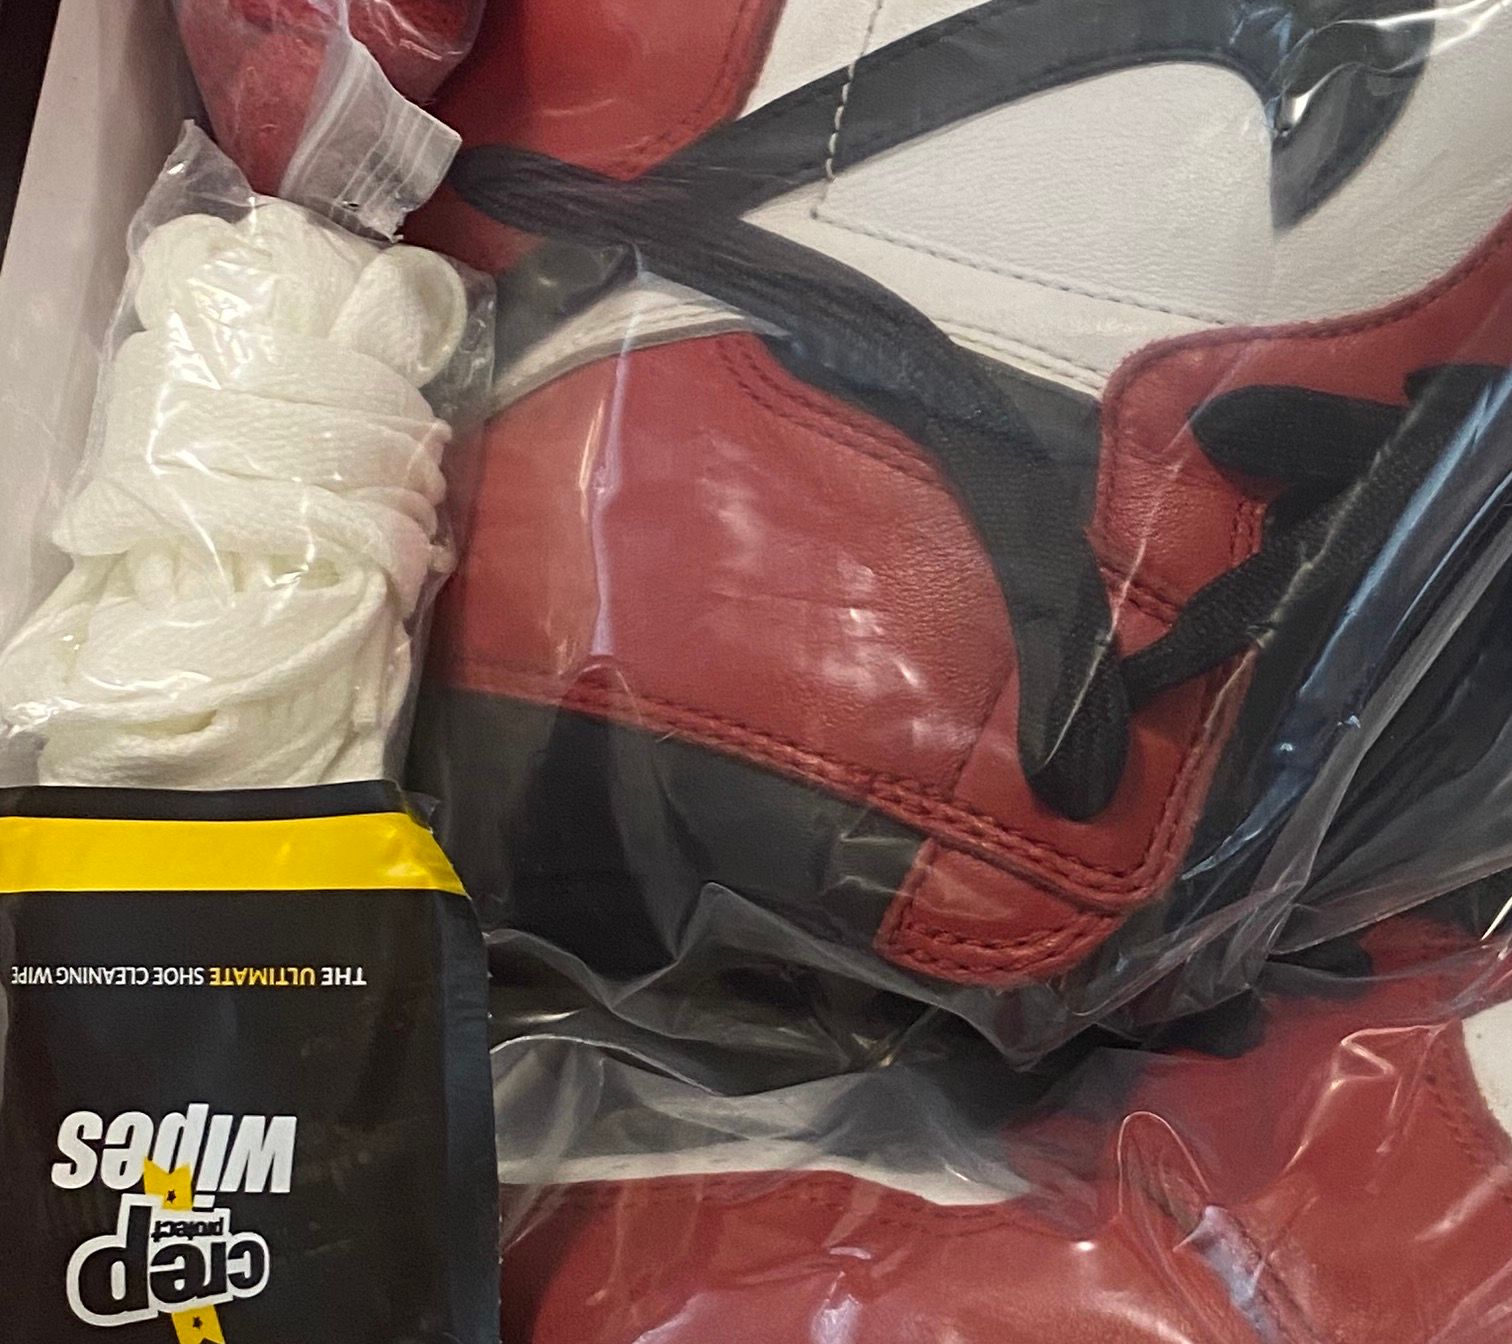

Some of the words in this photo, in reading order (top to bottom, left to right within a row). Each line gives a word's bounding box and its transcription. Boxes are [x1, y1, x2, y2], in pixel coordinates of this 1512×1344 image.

[11, 965, 52, 986] WIPE
[55, 966, 150, 986] CLEANING
[151, 966, 205, 986] SHOE
[208, 966, 316, 987] ULTIMATE
[319, 966, 368, 987] THE
[50, 1102, 298, 1208] wipes
[150, 1216, 225, 1243] protect
[70, 1199, 268, 1322] crep
